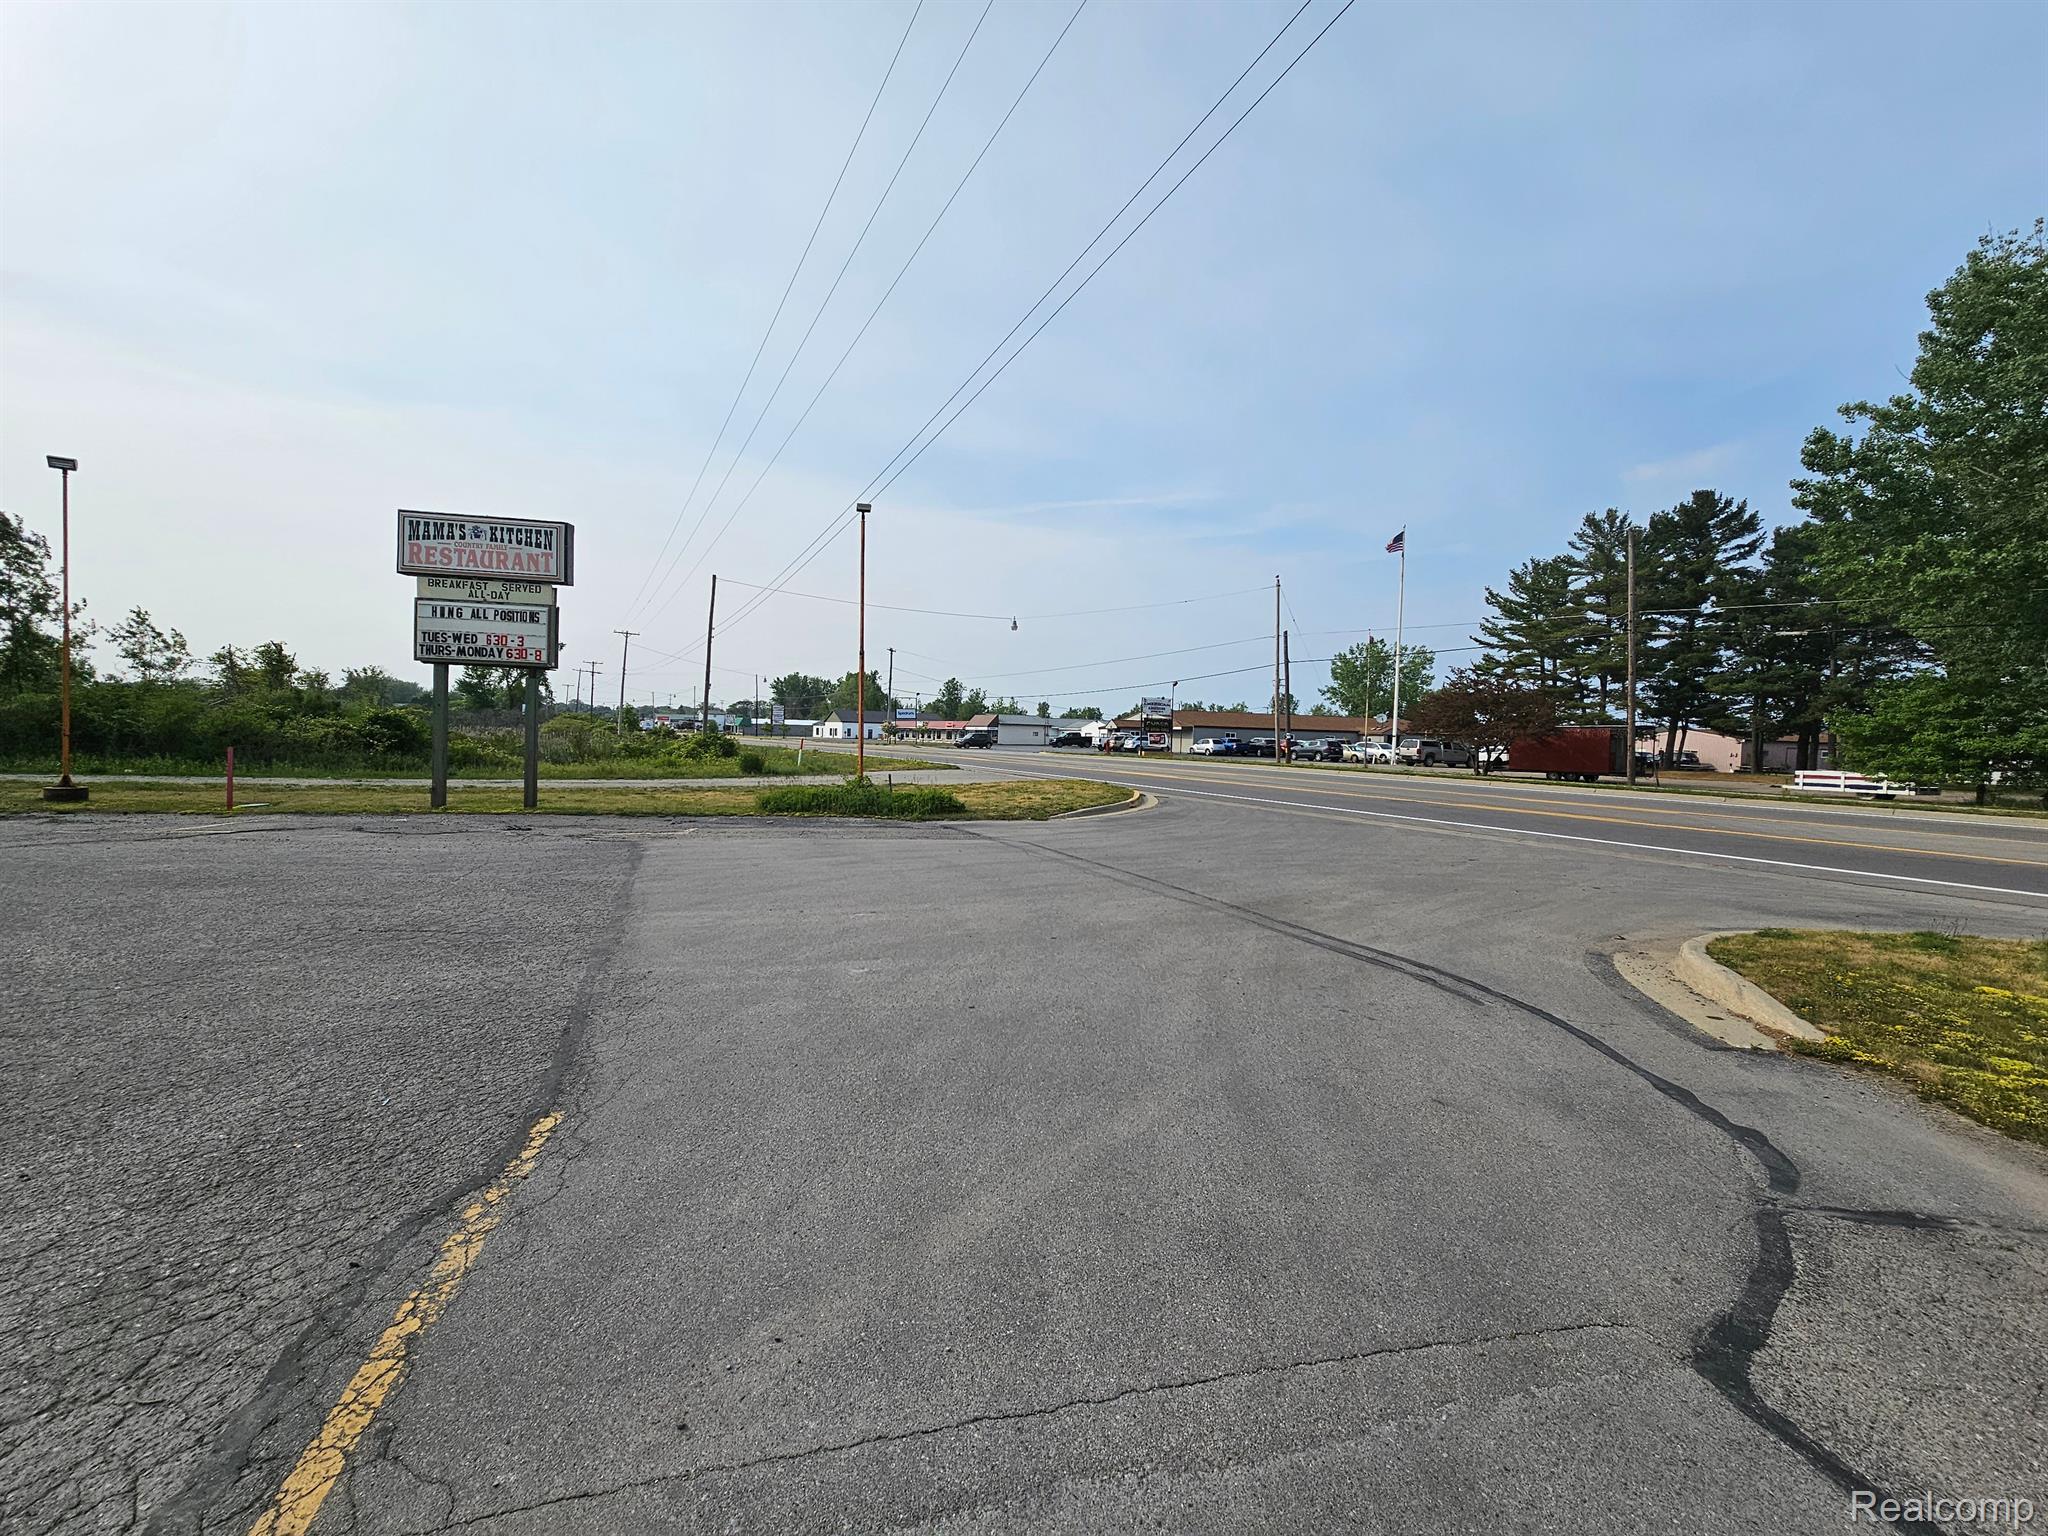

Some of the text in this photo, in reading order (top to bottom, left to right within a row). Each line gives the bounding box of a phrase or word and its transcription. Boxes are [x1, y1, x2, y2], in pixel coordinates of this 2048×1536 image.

[408, 519, 553, 551] MAMA'S KITCHEN
[454, 541, 507, 551] COUNTRY FAMILY
[408, 542, 553, 573] RESTAURANT
[427, 578, 541, 594] BREAKFAST SERVED
[468, 590, 510, 600] ALL-DAY
[470, 608, 488, 619] ALL
[493, 609, 540, 623] POSITIONS
[421, 631, 478, 644] TUES-WED
[419, 643, 503, 659] THURS-MONDAY
